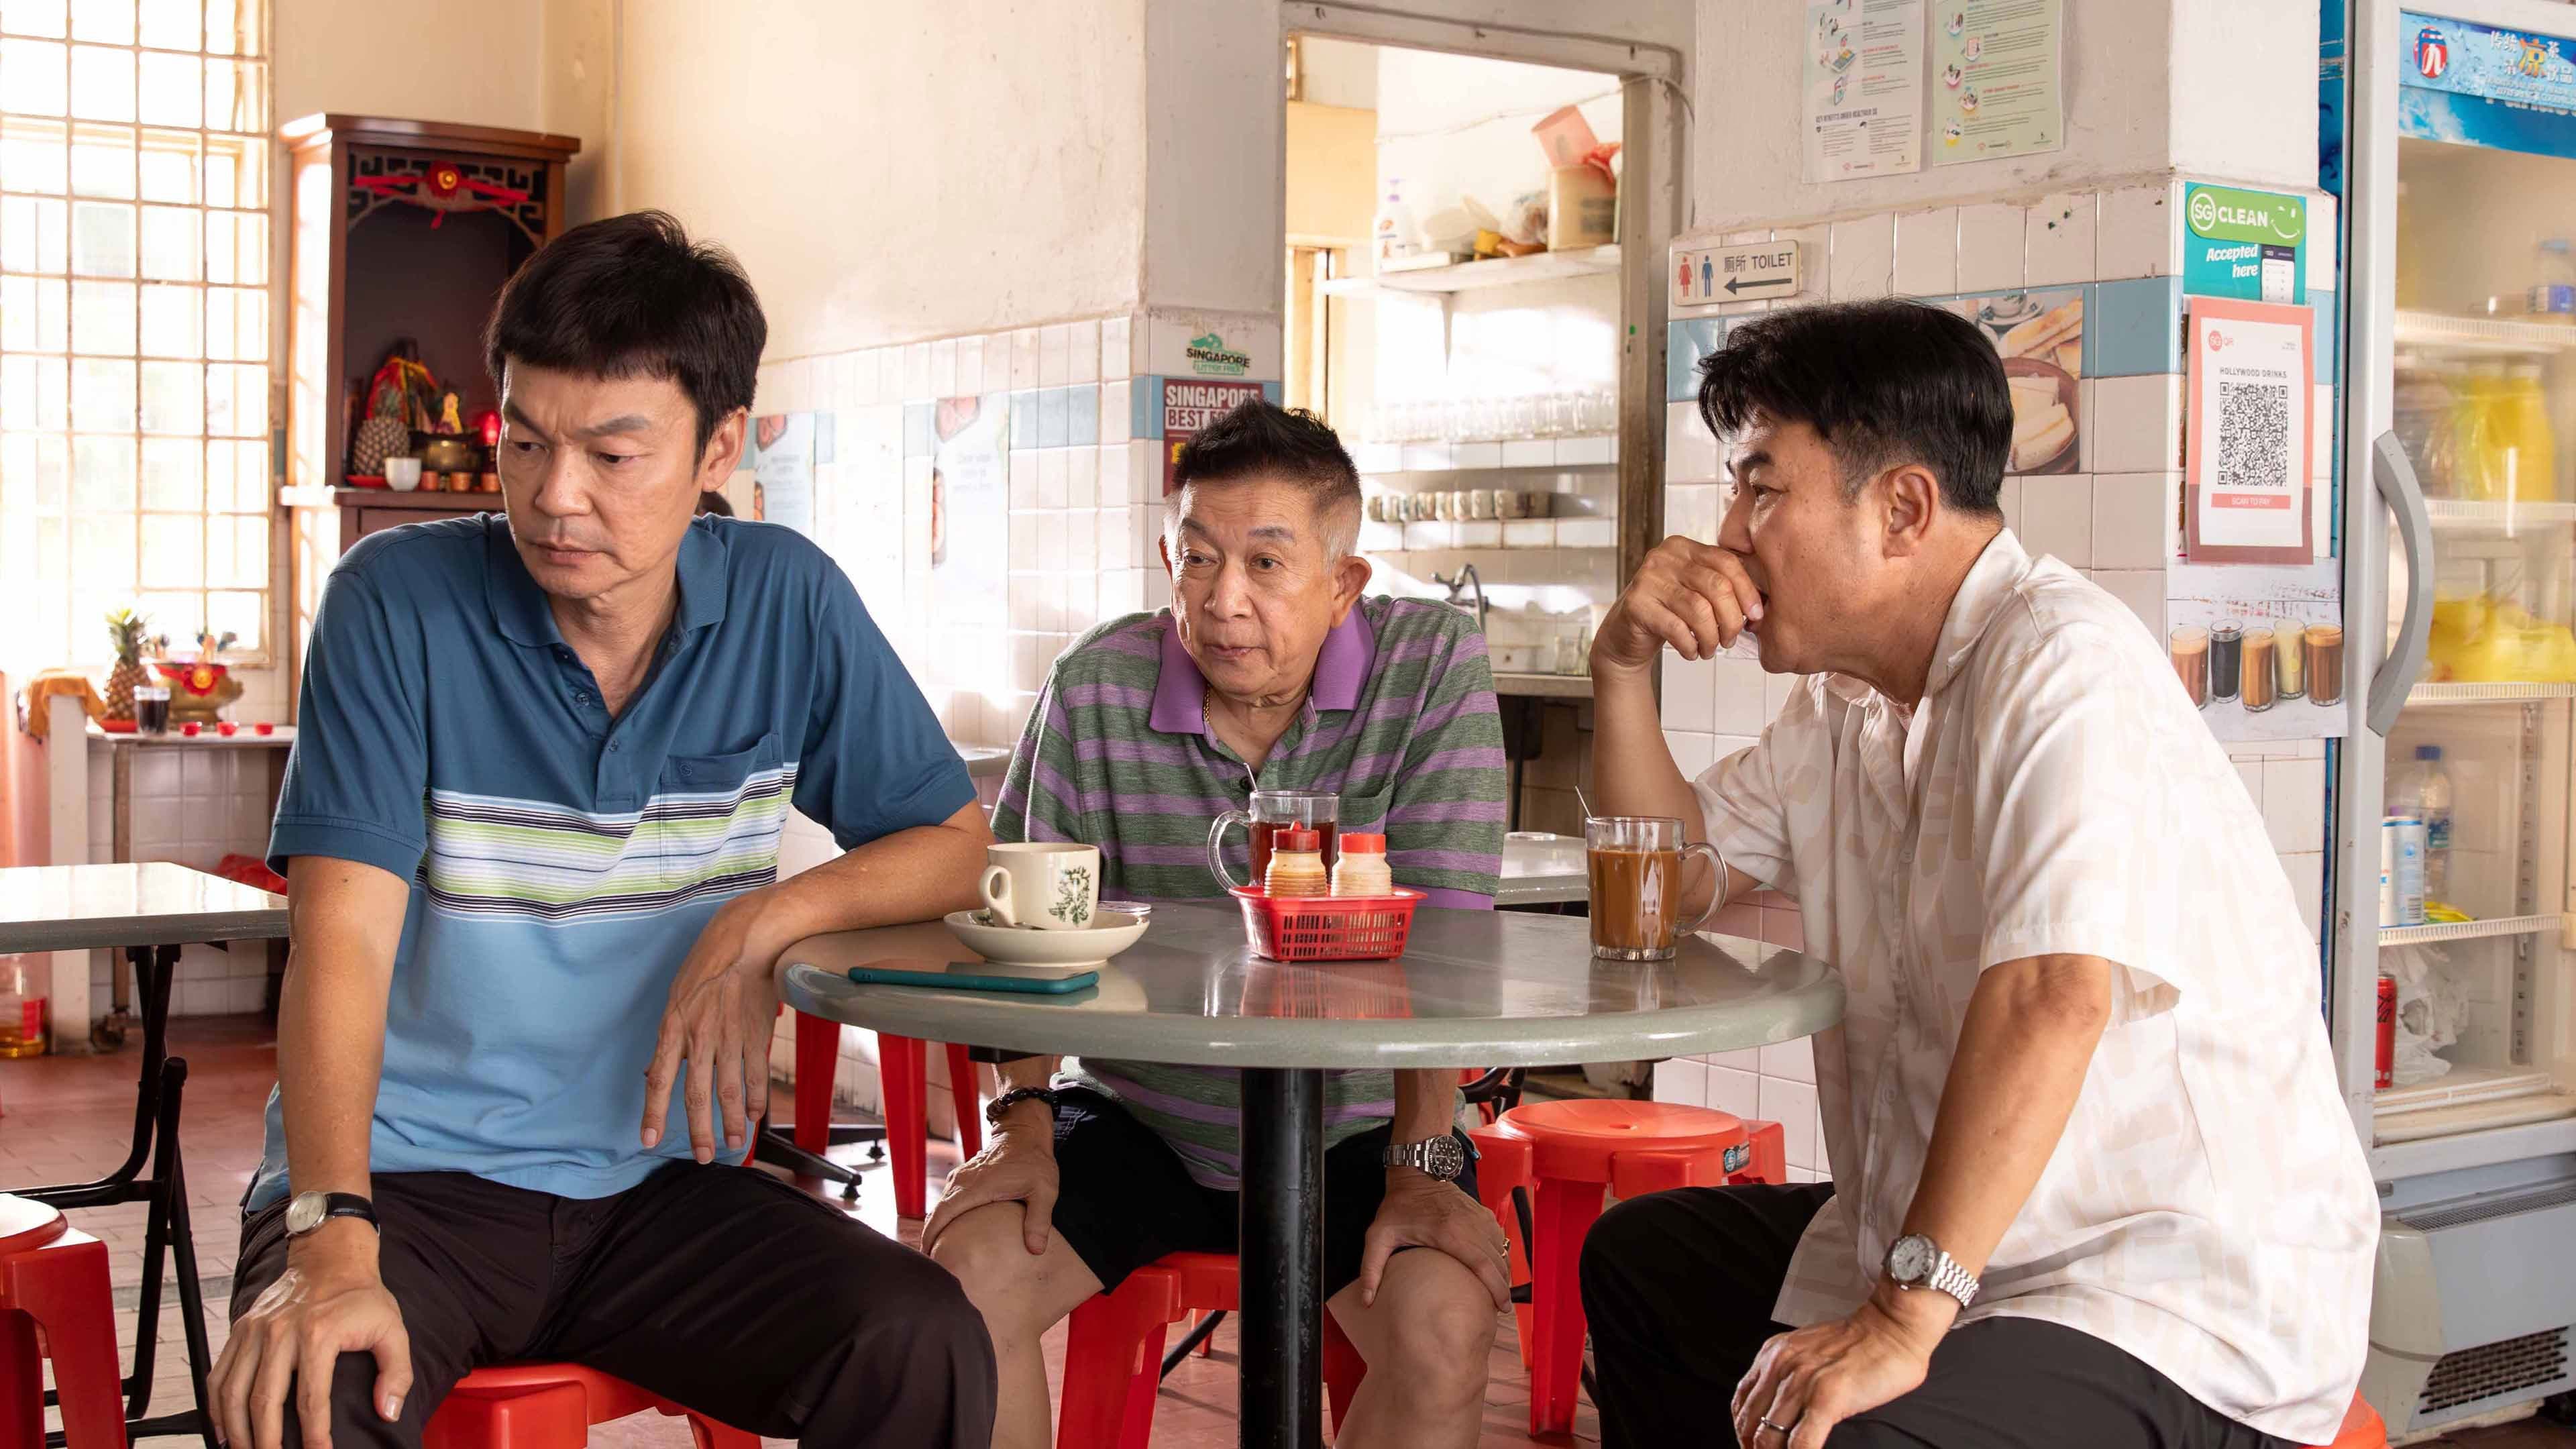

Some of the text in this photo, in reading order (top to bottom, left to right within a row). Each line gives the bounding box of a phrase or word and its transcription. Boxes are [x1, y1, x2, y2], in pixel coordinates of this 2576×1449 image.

[2194, 205, 2269, 227] SG CLEAN
[1751, 252, 1793, 269] TOILET
[2206, 244, 2259, 262] Accepted
[2232, 264, 2259, 278] here
[1186, 347, 1251, 368] SINGAPORE
[2219, 367, 2288, 379] HOLLYWOOD DRINKS
[1168, 409, 1205, 427] BEST
